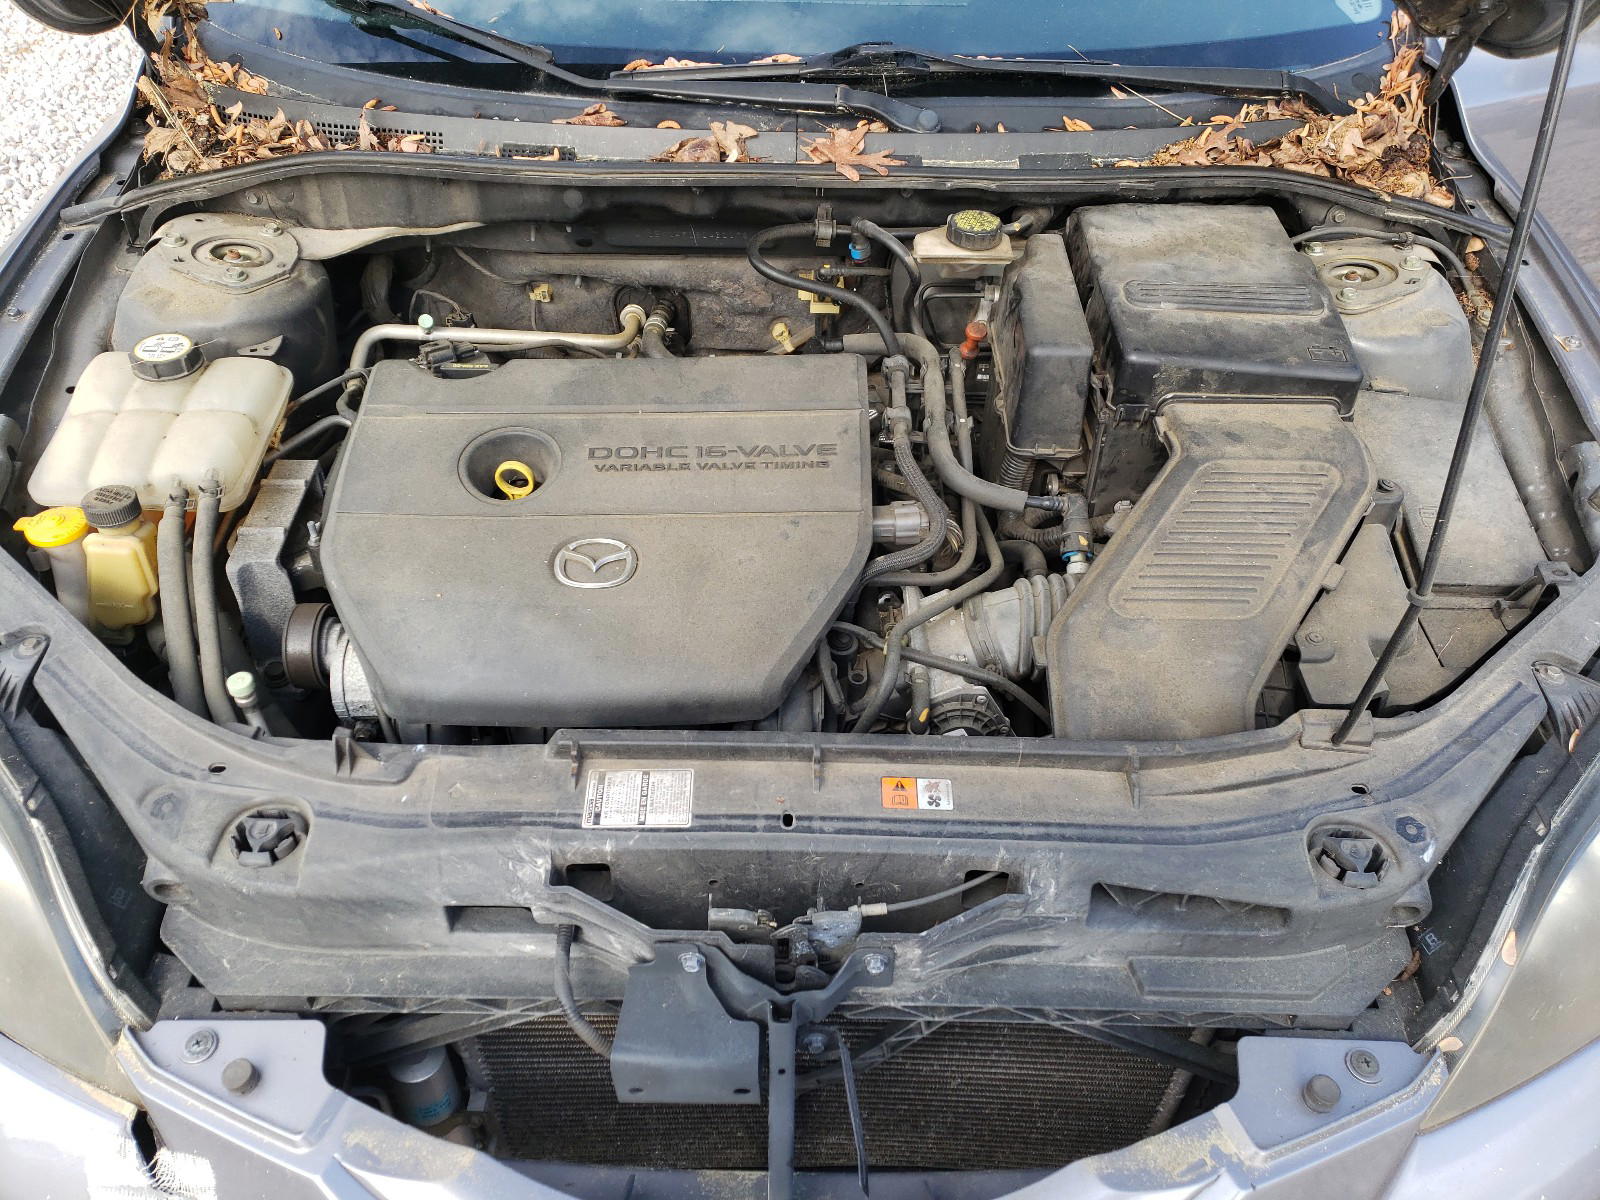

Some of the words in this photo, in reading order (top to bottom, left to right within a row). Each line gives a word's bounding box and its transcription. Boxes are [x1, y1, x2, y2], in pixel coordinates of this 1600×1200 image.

[587, 446, 688, 461] DOHC
[696, 443, 838, 460] 16-VALVE
[594, 463, 691, 473] VARIABLE
[696, 462, 756, 471] VALVE
[761, 460, 830, 470] TIMING
[595, 784, 604, 812] CAUTION
[640, 796, 648, 805] EN
[638, 806, 646, 822] MISE
